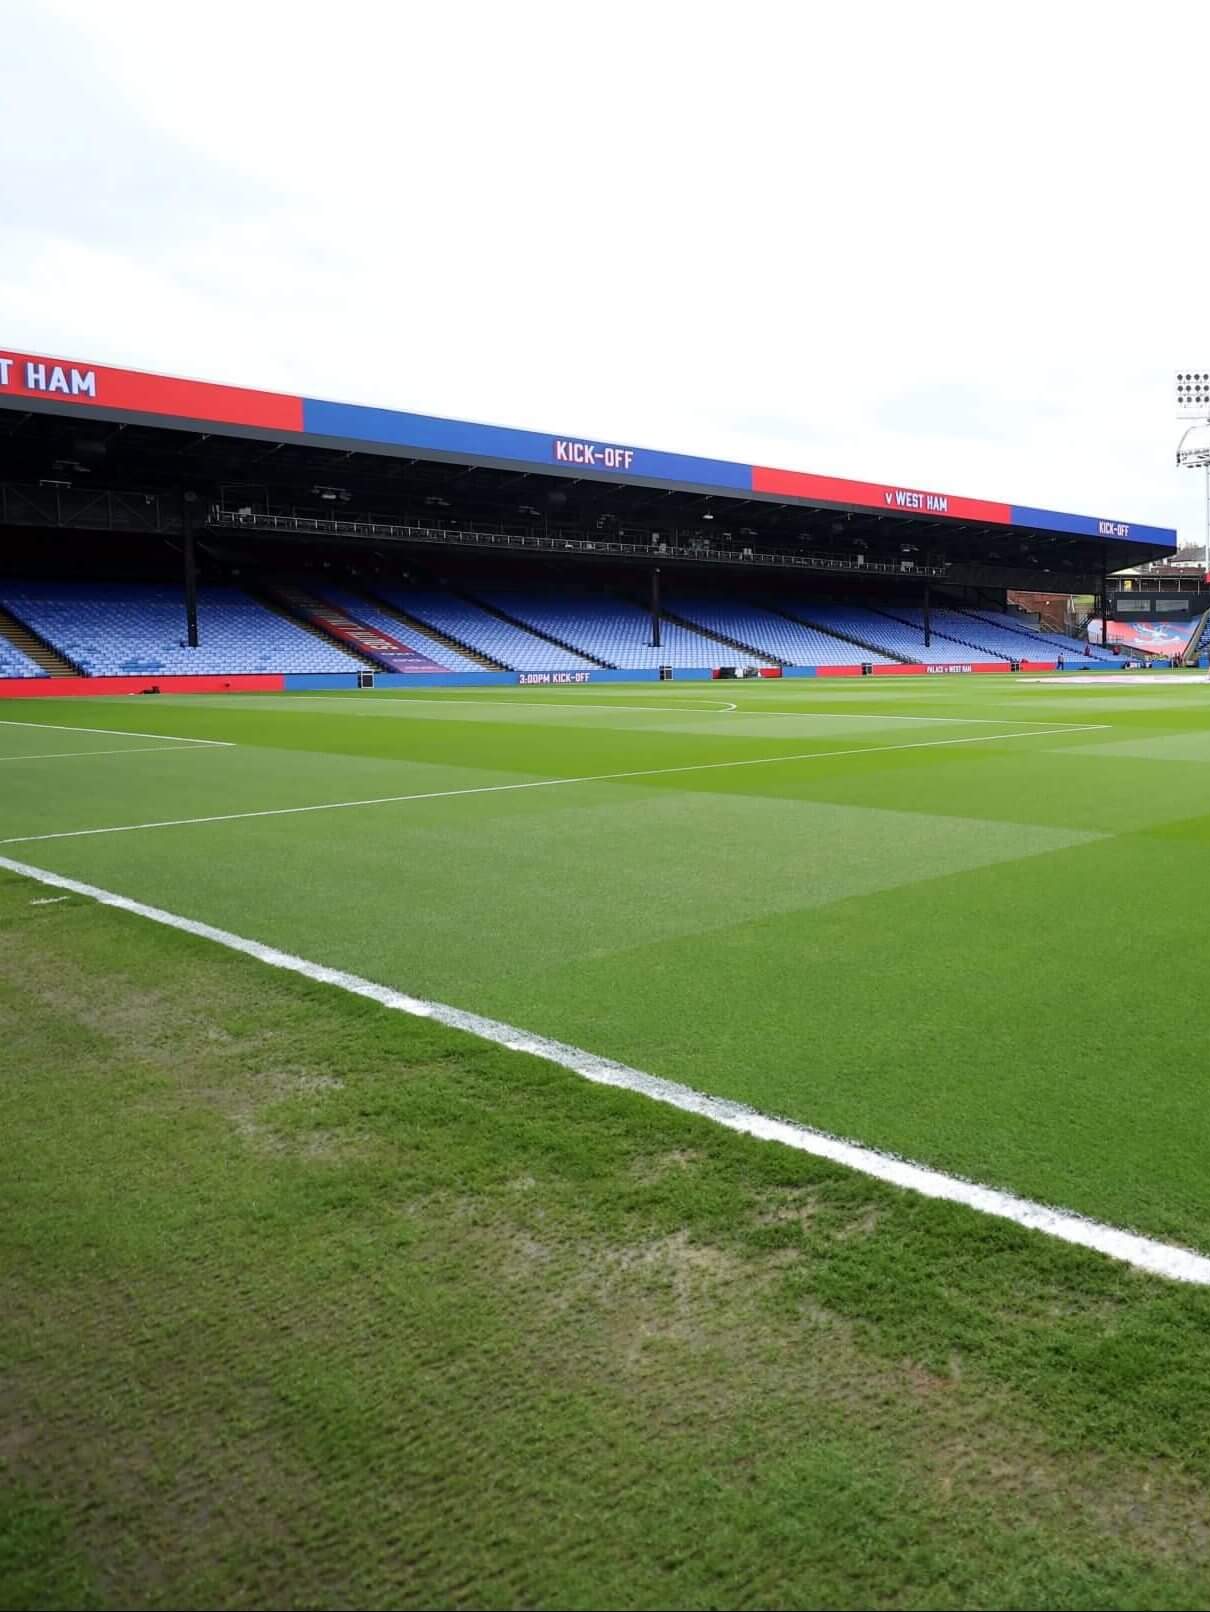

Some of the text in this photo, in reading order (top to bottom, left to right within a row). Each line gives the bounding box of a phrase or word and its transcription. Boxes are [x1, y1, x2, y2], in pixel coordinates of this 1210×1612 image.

[26, 361, 97, 397] HAM
[555, 440, 634, 469] KICK-OFF
[895, 489, 924, 509] WEST
[926, 495, 948, 513] HAM
[1099, 520, 1129, 537] KICK-OFF
[552, 672, 592, 683] KICK-OFF
